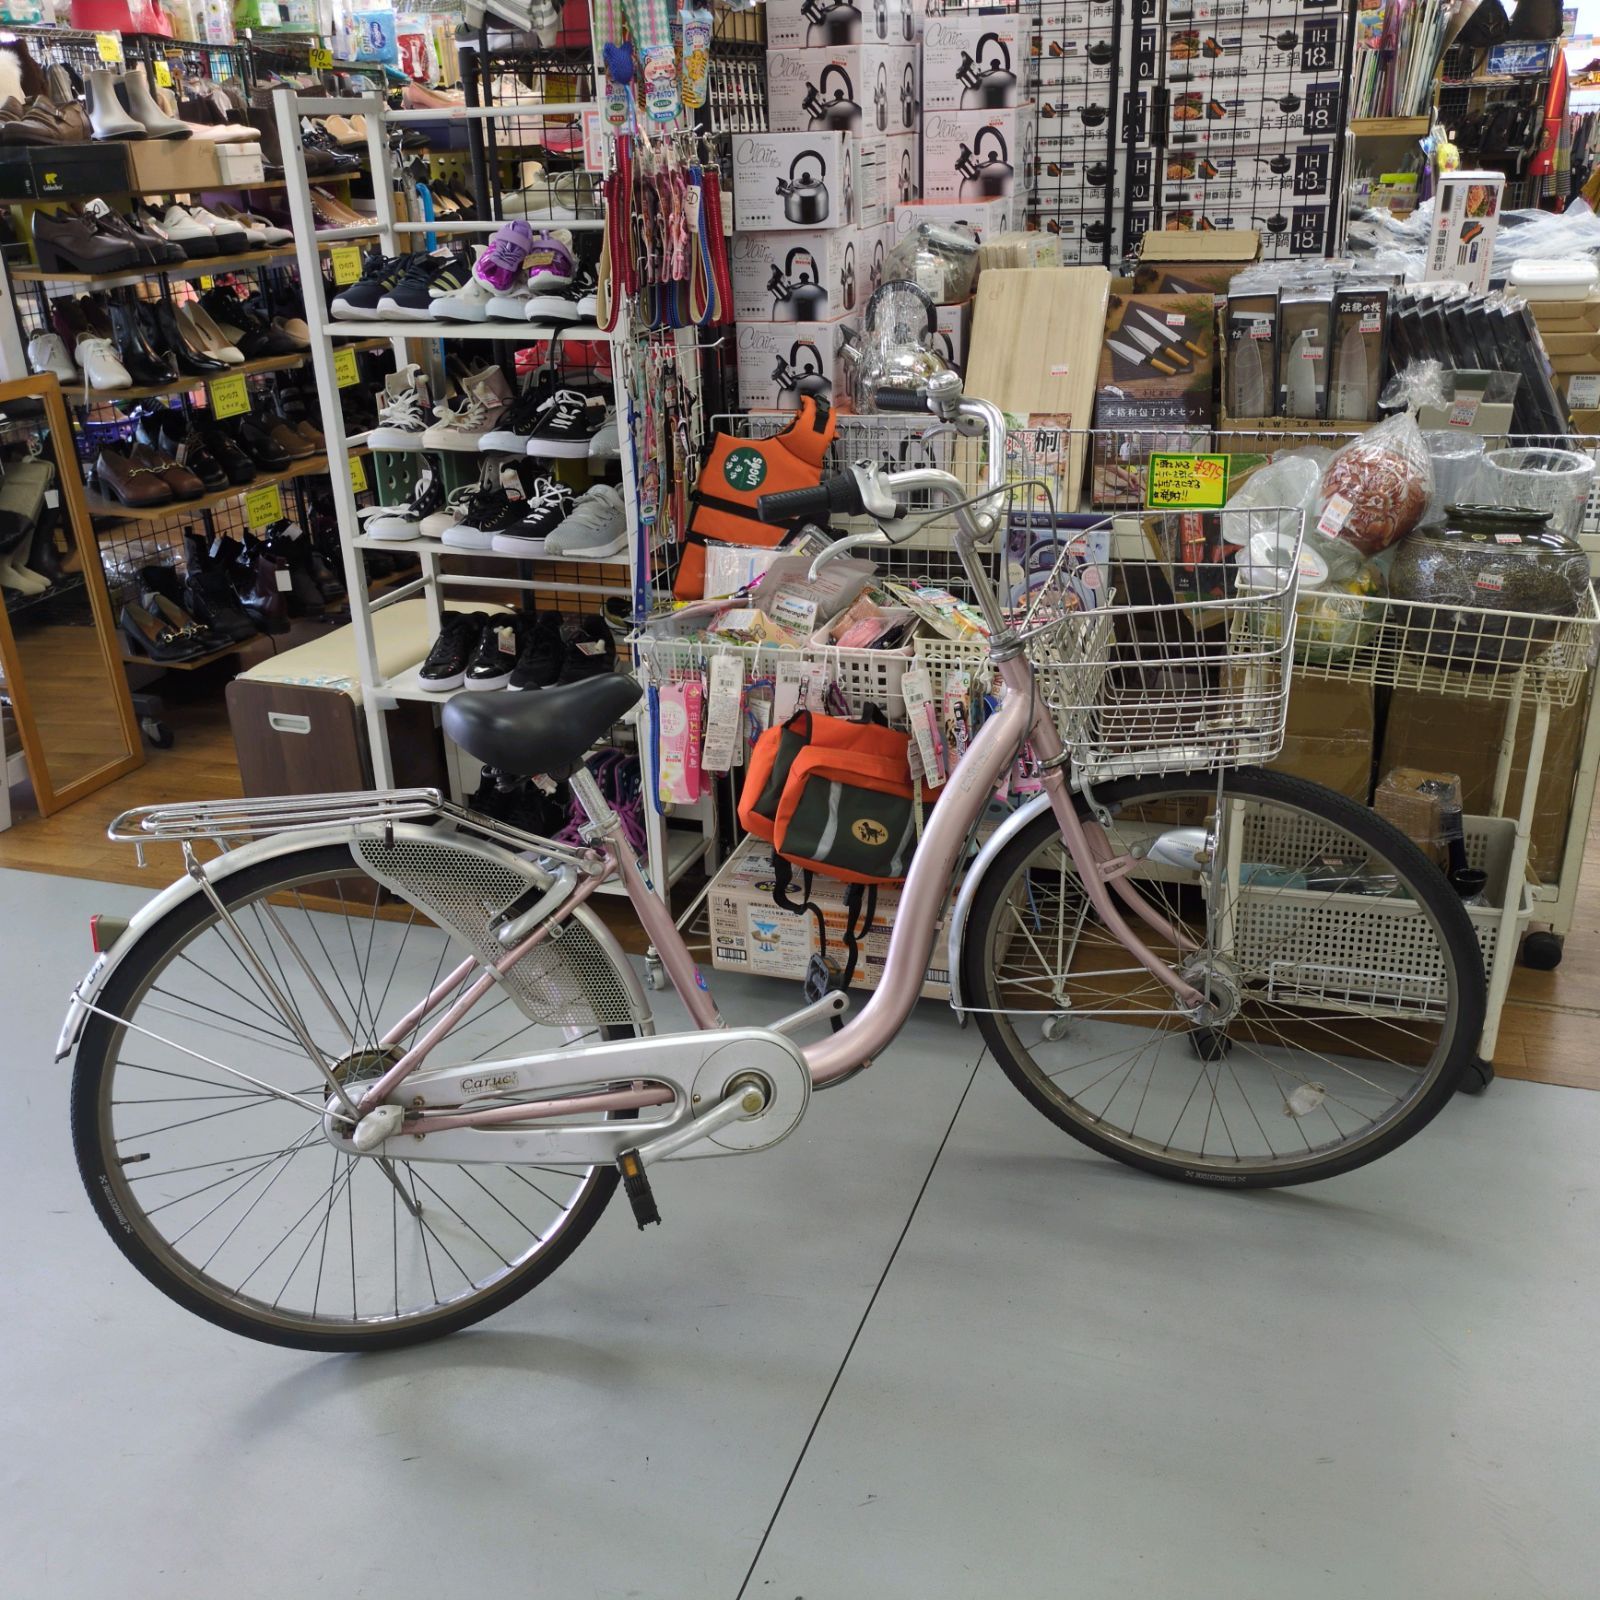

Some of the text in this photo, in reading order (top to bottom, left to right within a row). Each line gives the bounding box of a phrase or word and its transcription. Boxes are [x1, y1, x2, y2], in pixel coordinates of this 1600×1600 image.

[1312, 28, 1328, 43] IH
[1256, 51, 1301, 69] 片手鍋
[1314, 92, 1331, 107] IH
[1261, 114, 1304, 131] 片手鍋
[1304, 154, 1321, 169] IH
[1250, 175, 1294, 193] 片手鍋
[1300, 213, 1317, 228] IH
[1262, 231, 1291, 249] 手鍋
[1340, 301, 1382, 313] 伝統の技
[1105, 406, 1205, 417] 本格和包丁3本セット
